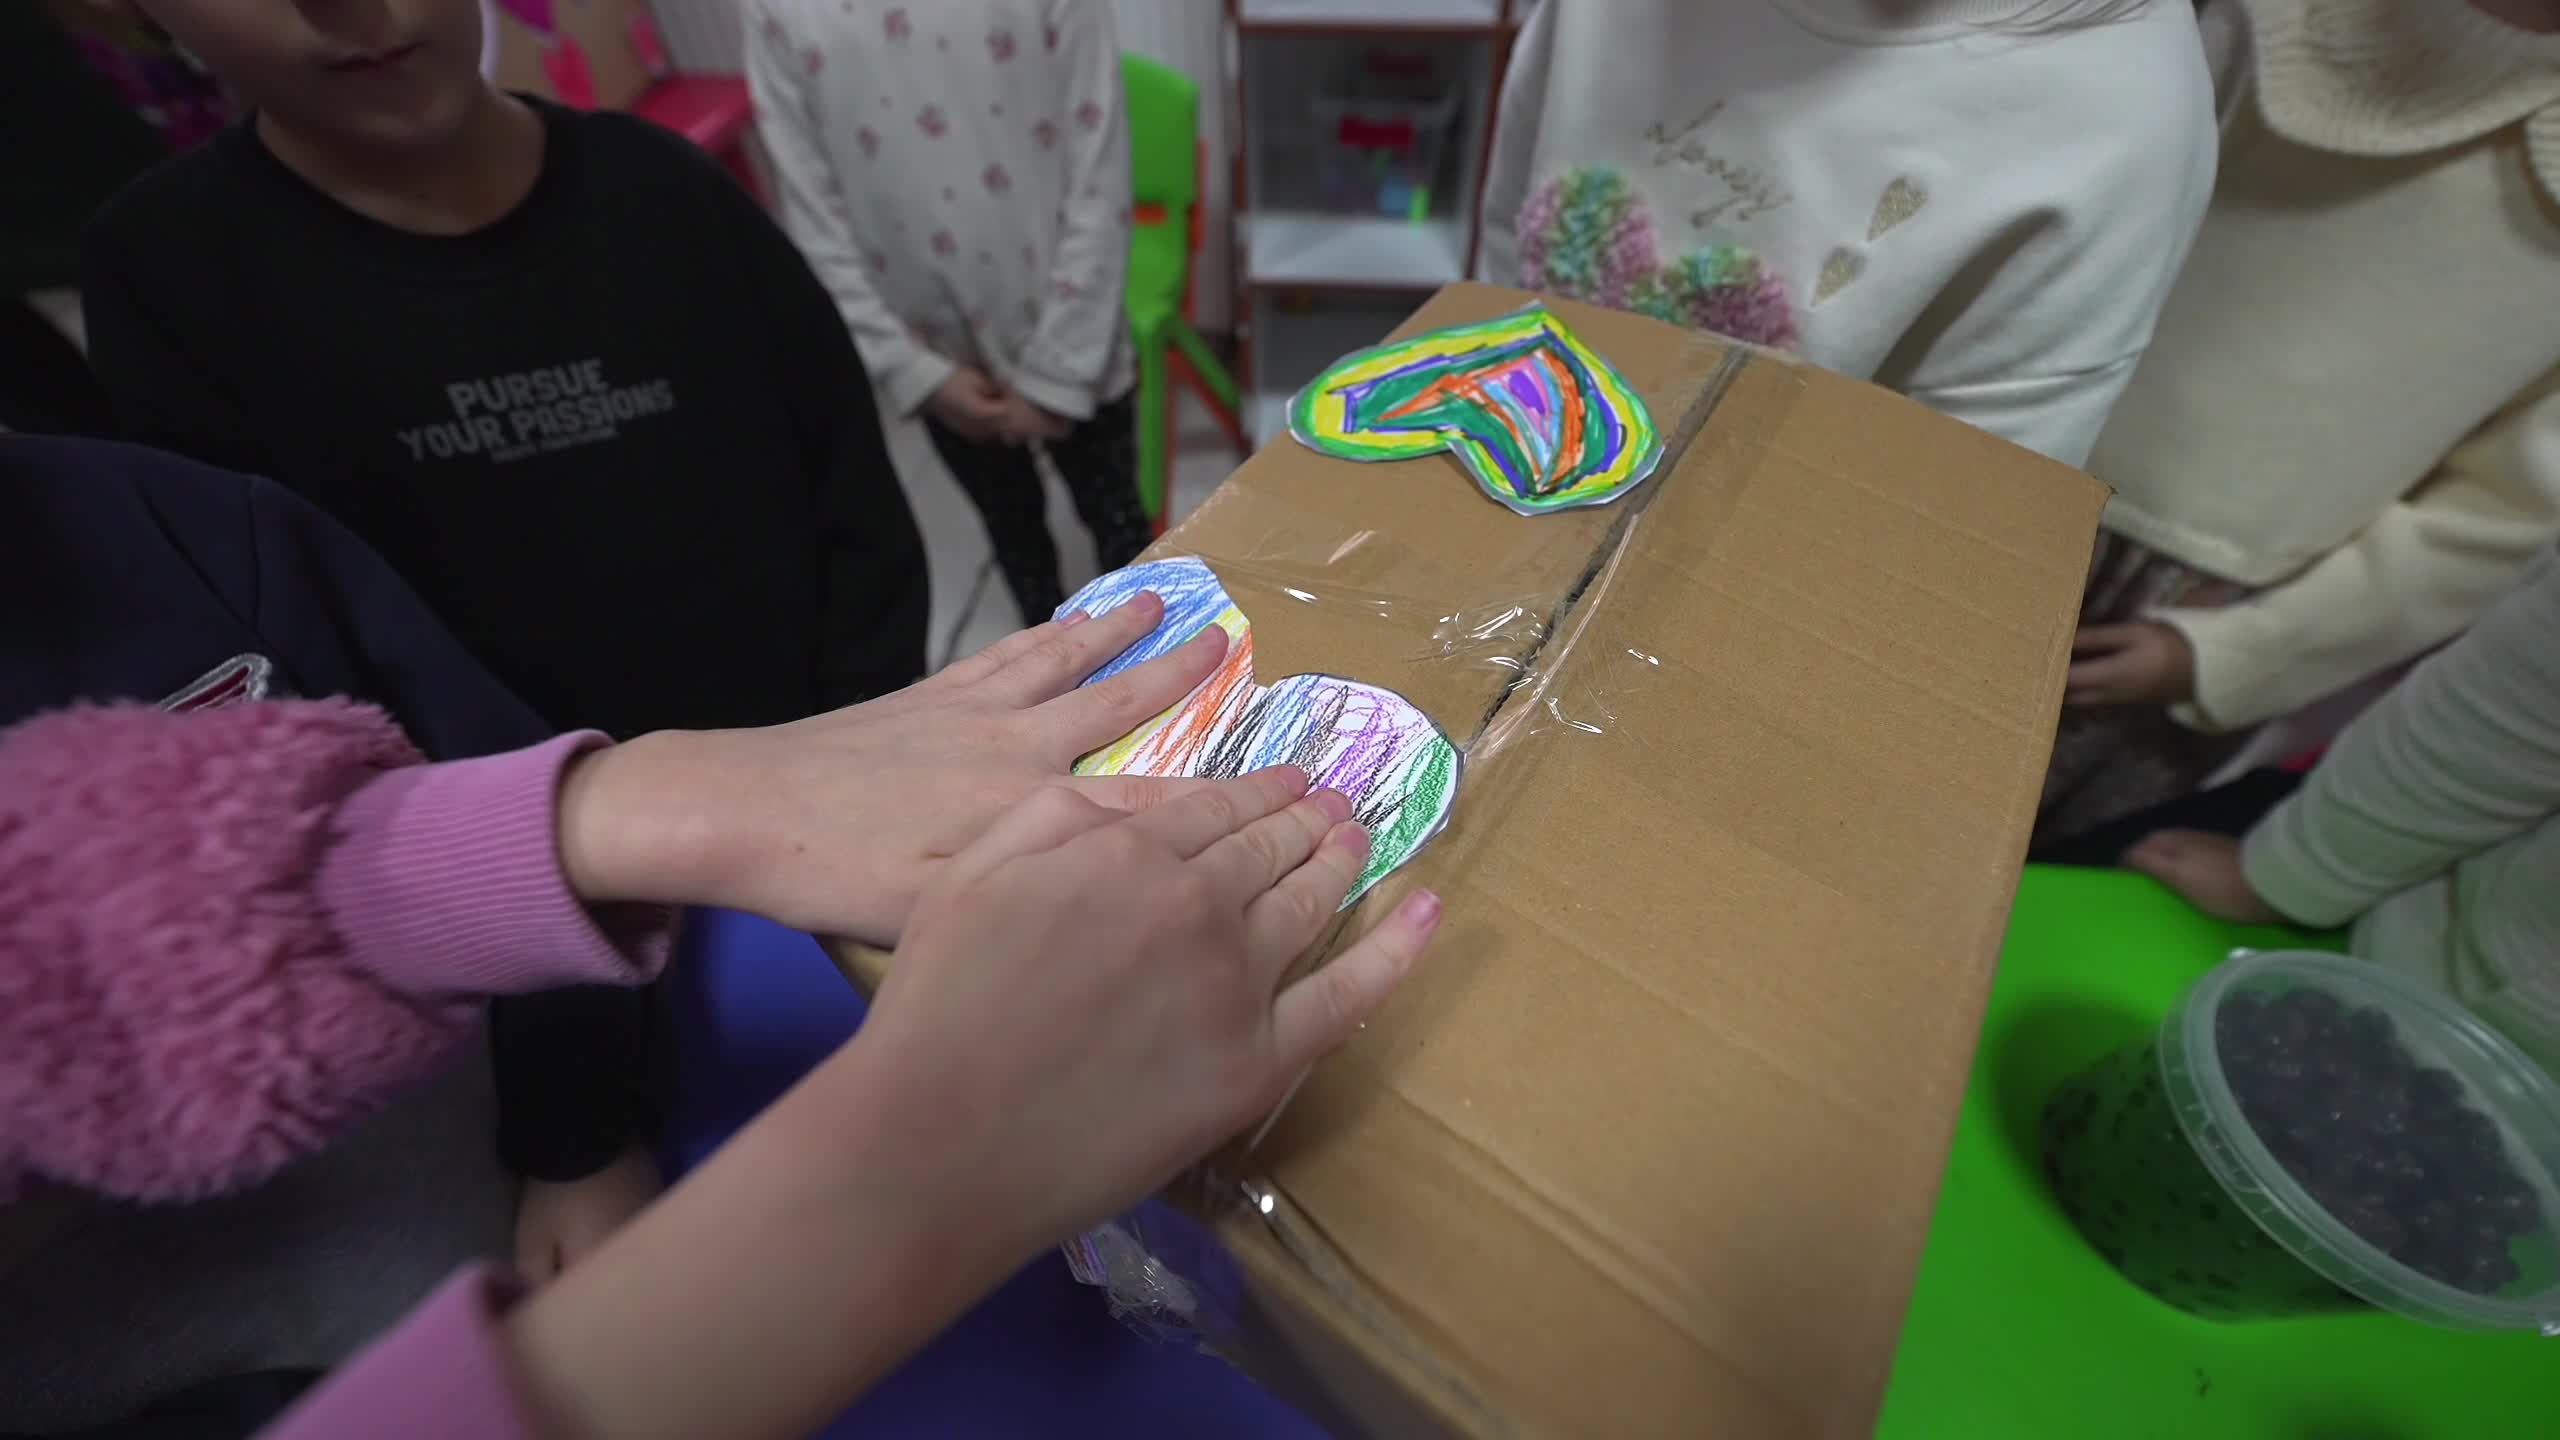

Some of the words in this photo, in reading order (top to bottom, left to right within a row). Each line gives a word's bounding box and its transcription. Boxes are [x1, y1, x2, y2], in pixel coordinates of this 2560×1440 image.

[397, 416, 506, 462] YOUR
[510, 379, 674, 441] PASSIONS
[446, 358, 608, 417] PURSUE
